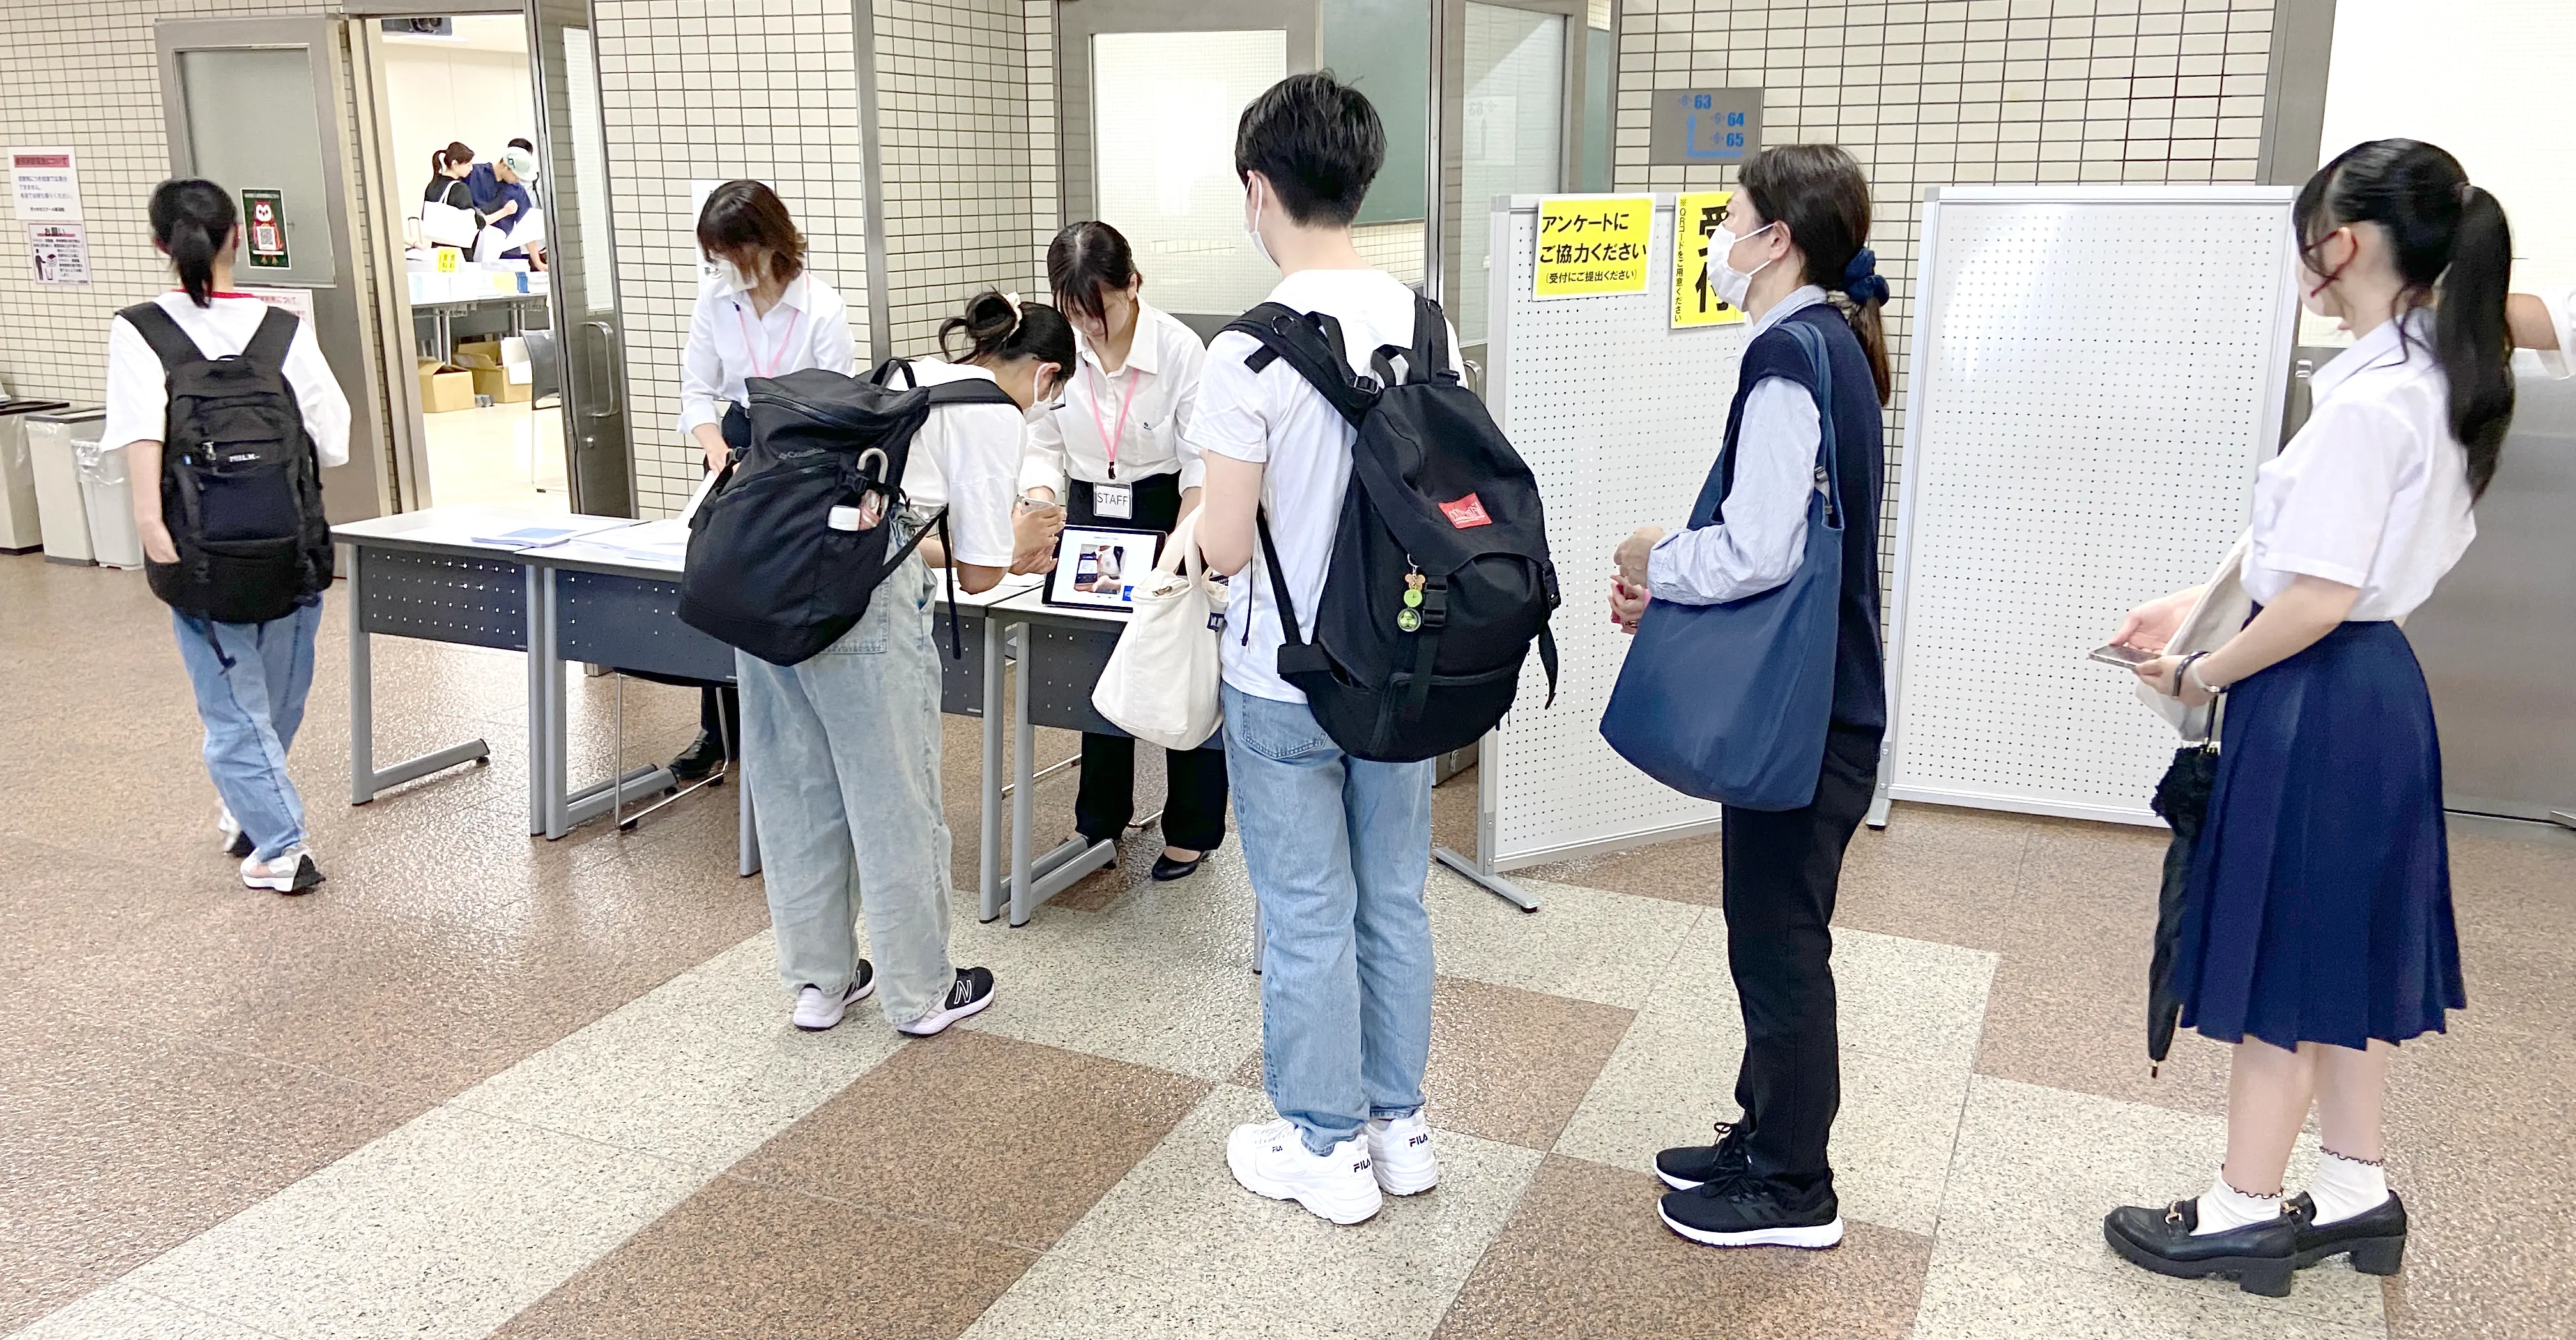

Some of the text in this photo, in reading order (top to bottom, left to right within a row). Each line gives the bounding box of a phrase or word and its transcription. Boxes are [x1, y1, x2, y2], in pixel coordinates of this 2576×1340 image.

[1694, 95, 1712, 109] 63
[1728, 112, 1745, 127] 64
[1726, 132, 1744, 147] 65
[1542, 212, 1630, 233] アンケートに
[1540, 243, 1647, 264] ご協力ください
[1545, 270, 1637, 284] (受付にご提出ください)
[787, 448, 826, 459] Columbia
[1096, 492, 1129, 506] STAFF
[953, 979, 972, 1005] N
[1409, 1132, 1429, 1148] FILA
[1272, 1145, 1284, 1153] FILA
[1353, 1158, 1372, 1173] FILA
